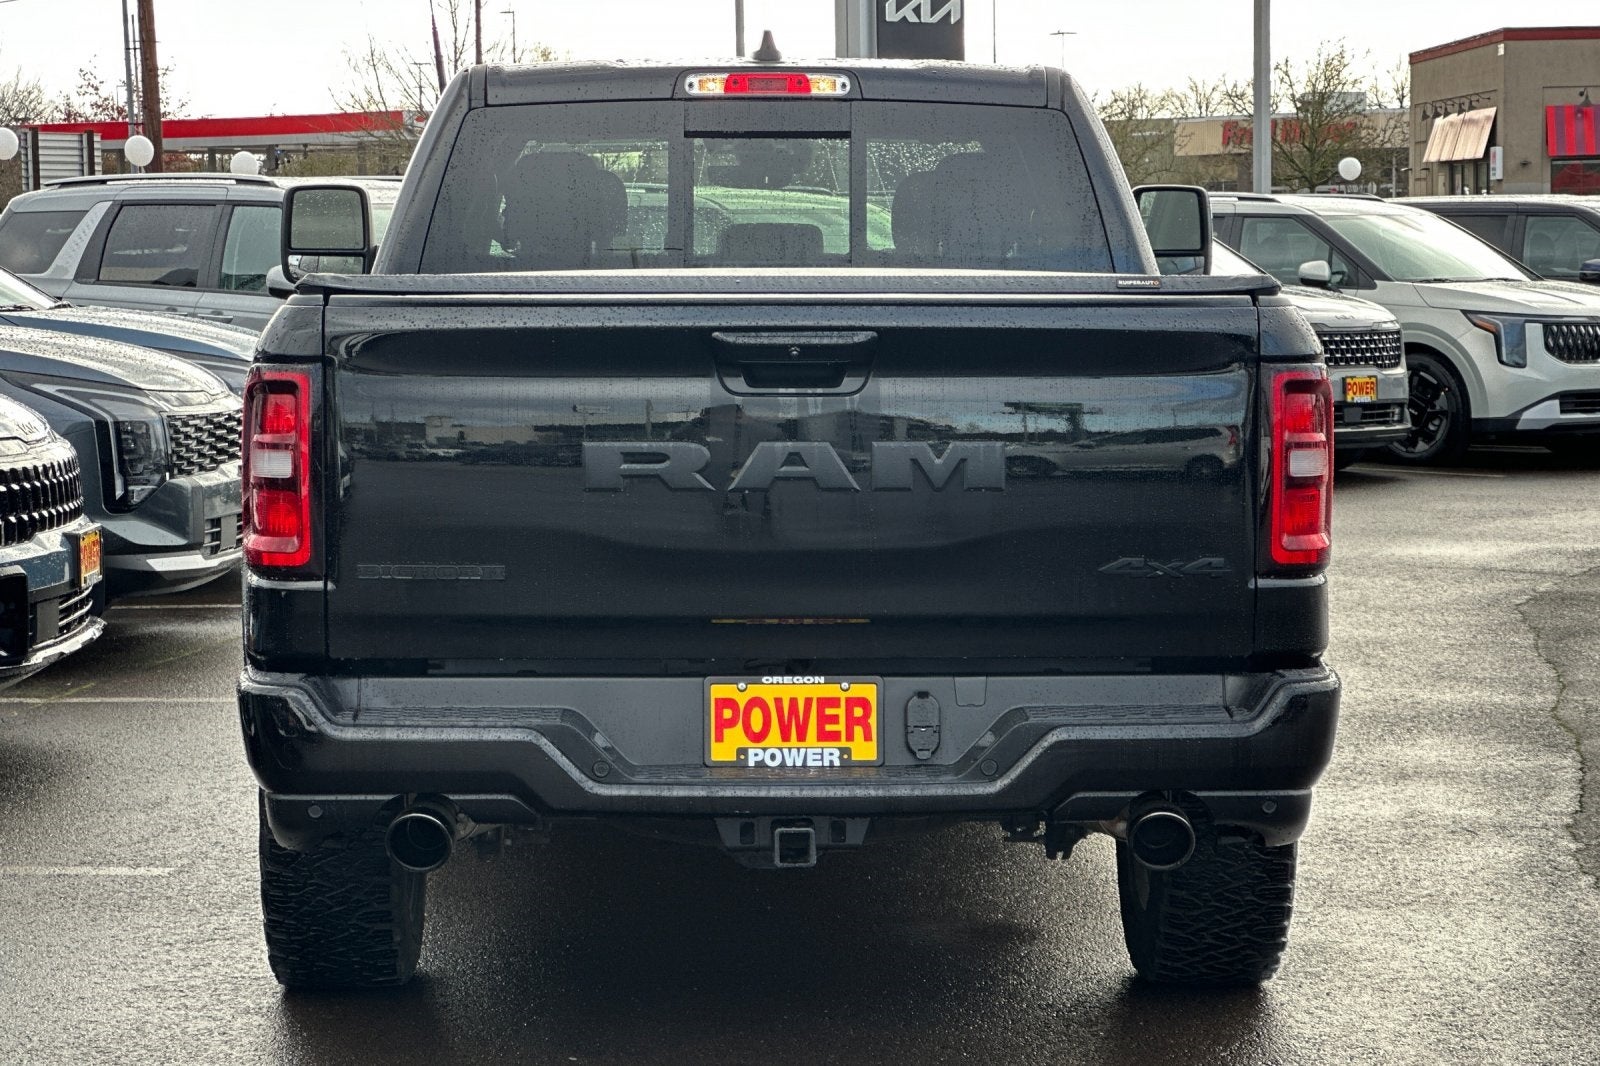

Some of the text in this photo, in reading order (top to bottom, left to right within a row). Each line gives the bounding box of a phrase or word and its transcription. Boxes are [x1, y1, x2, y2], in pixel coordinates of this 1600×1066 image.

[886, 0, 961, 24] KIA
[1346, 381, 1376, 396] POWER
[582, 441, 1006, 492] RAM
[1098, 556, 1231, 579] 4x4
[761, 675, 825, 684] OREGON
[714, 696, 873, 744] POWER
[748, 748, 841, 767] POWER
